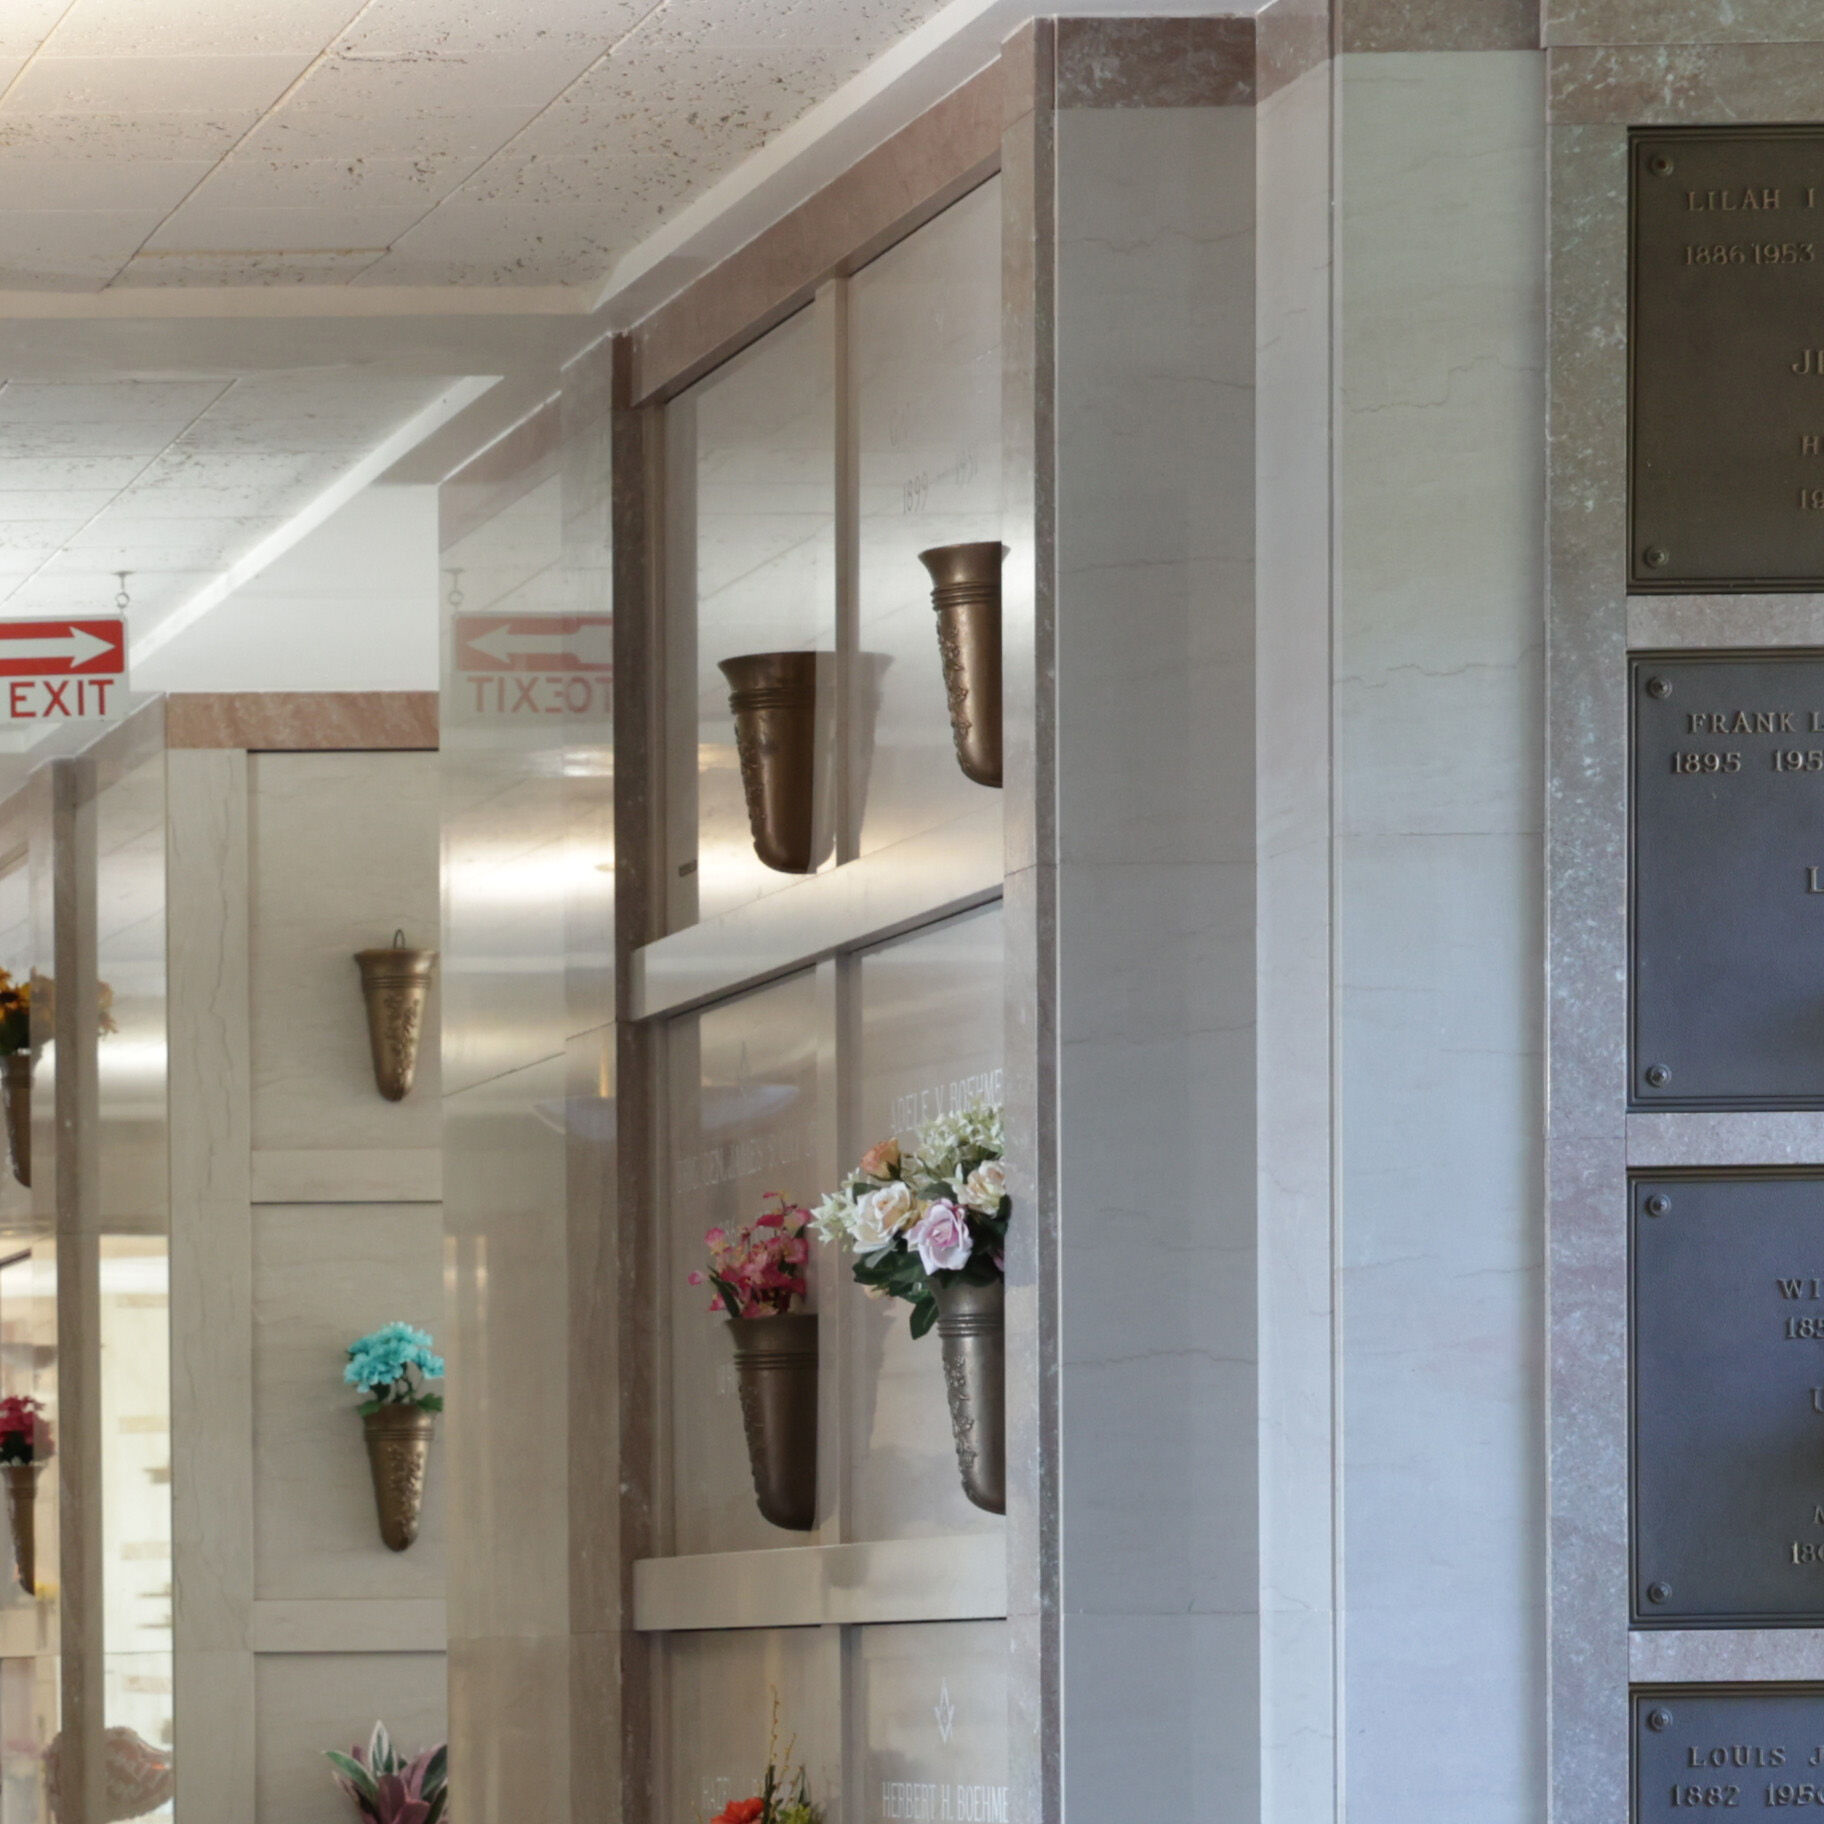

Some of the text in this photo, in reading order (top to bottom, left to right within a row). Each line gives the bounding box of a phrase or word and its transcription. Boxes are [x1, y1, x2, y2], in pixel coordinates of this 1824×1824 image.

[1687, 188, 1782, 212] LILAH
[1684, 243, 1815, 265] 1886 1953
[9, 678, 115, 718] EXIT
[1690, 711, 1797, 734] FRANK
[1673, 751, 1742, 774] 1895
[1689, 1745, 1787, 1768] LOUIS
[881, 1781, 936, 1821] HERBERT
[956, 1783, 1010, 1824] BOEHME
[1672, 1784, 1741, 1807] 1882
